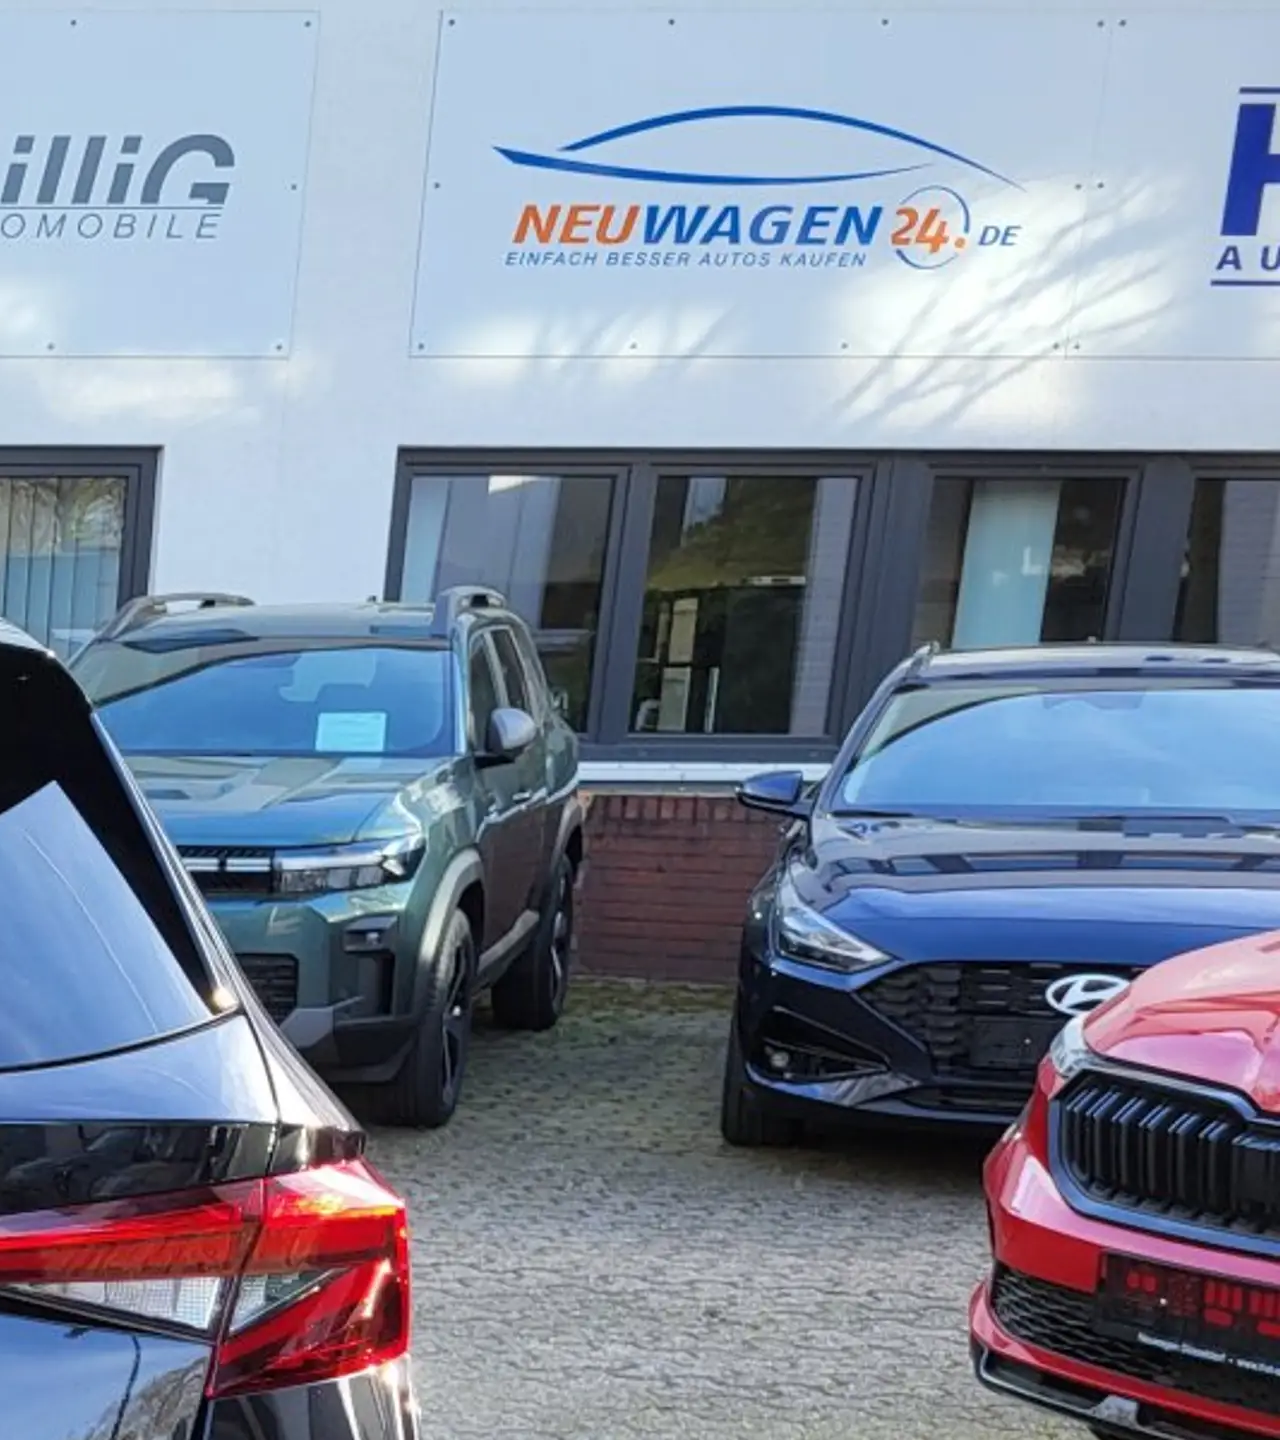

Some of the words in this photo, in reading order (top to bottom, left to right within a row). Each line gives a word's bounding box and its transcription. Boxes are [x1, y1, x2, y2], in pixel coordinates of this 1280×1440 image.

[505, 252, 598, 267] EINFACH
[605, 252, 690, 267] BESSER
[697, 252, 771, 267] AUTOS
[780, 252, 867, 268] KAUFEN
